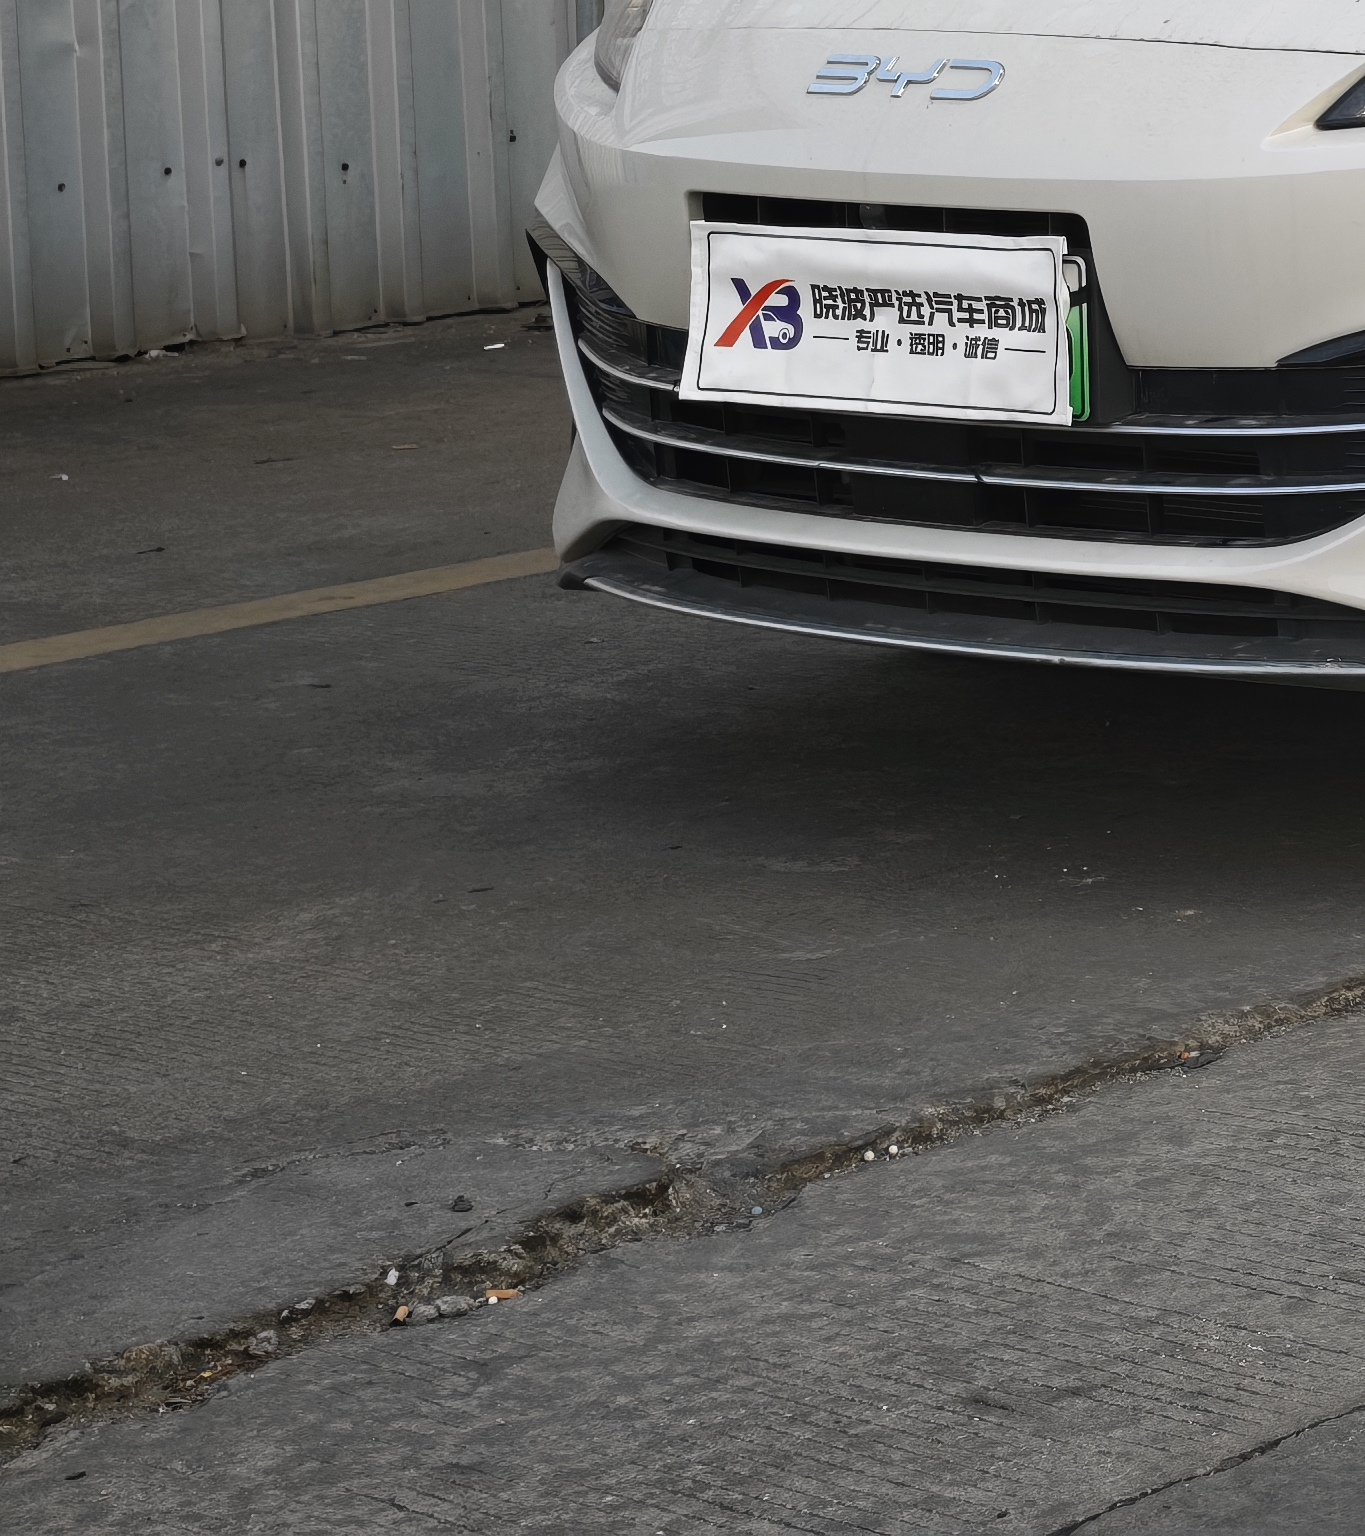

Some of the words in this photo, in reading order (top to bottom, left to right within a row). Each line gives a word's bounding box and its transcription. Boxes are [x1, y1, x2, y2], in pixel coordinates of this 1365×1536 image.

[806, 53, 1006, 102] BYD
[809, 283, 1048, 334] 晓波严选汽车商城
